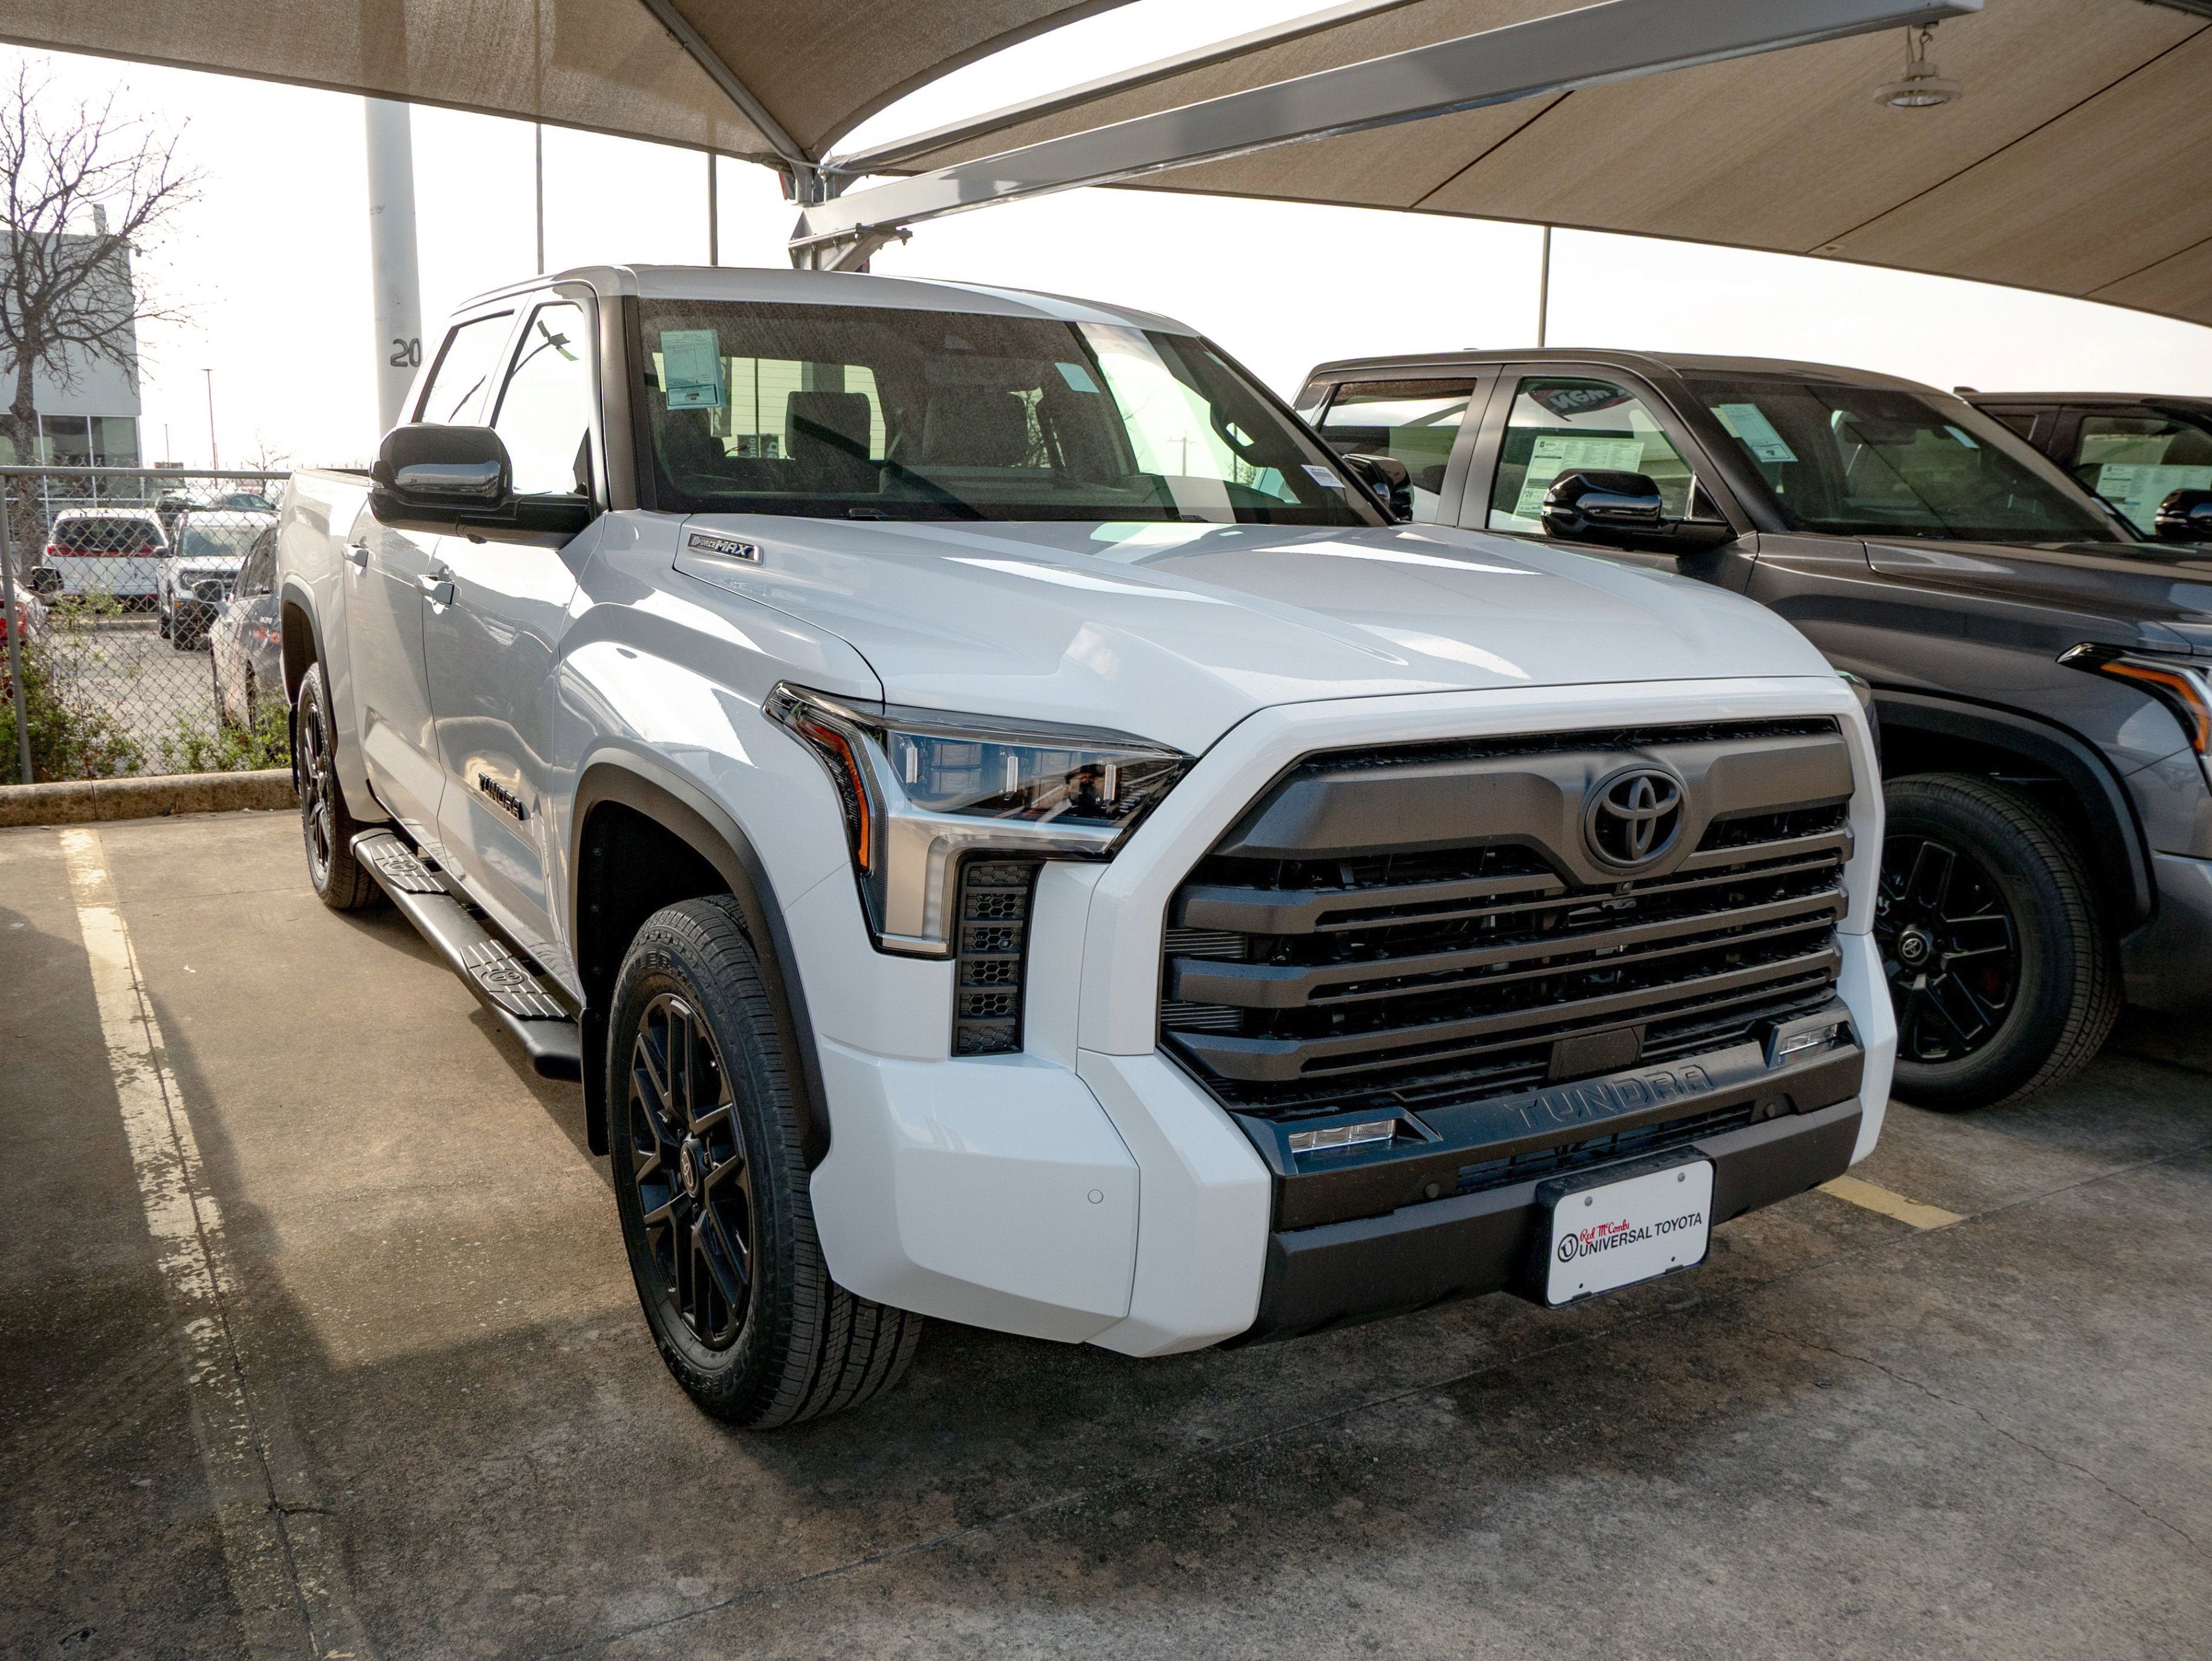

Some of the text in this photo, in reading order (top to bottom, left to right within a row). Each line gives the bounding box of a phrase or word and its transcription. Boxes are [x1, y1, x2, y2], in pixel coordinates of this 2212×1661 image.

[390, 338, 421, 367] 20
[715, 540, 752, 557] MAX
[1503, 1064, 1717, 1129] TUNDRA
[1579, 1212, 1703, 1257] UNIVERSAL TOYOTA
[1580, 1218, 1630, 1245] Red McCombs
